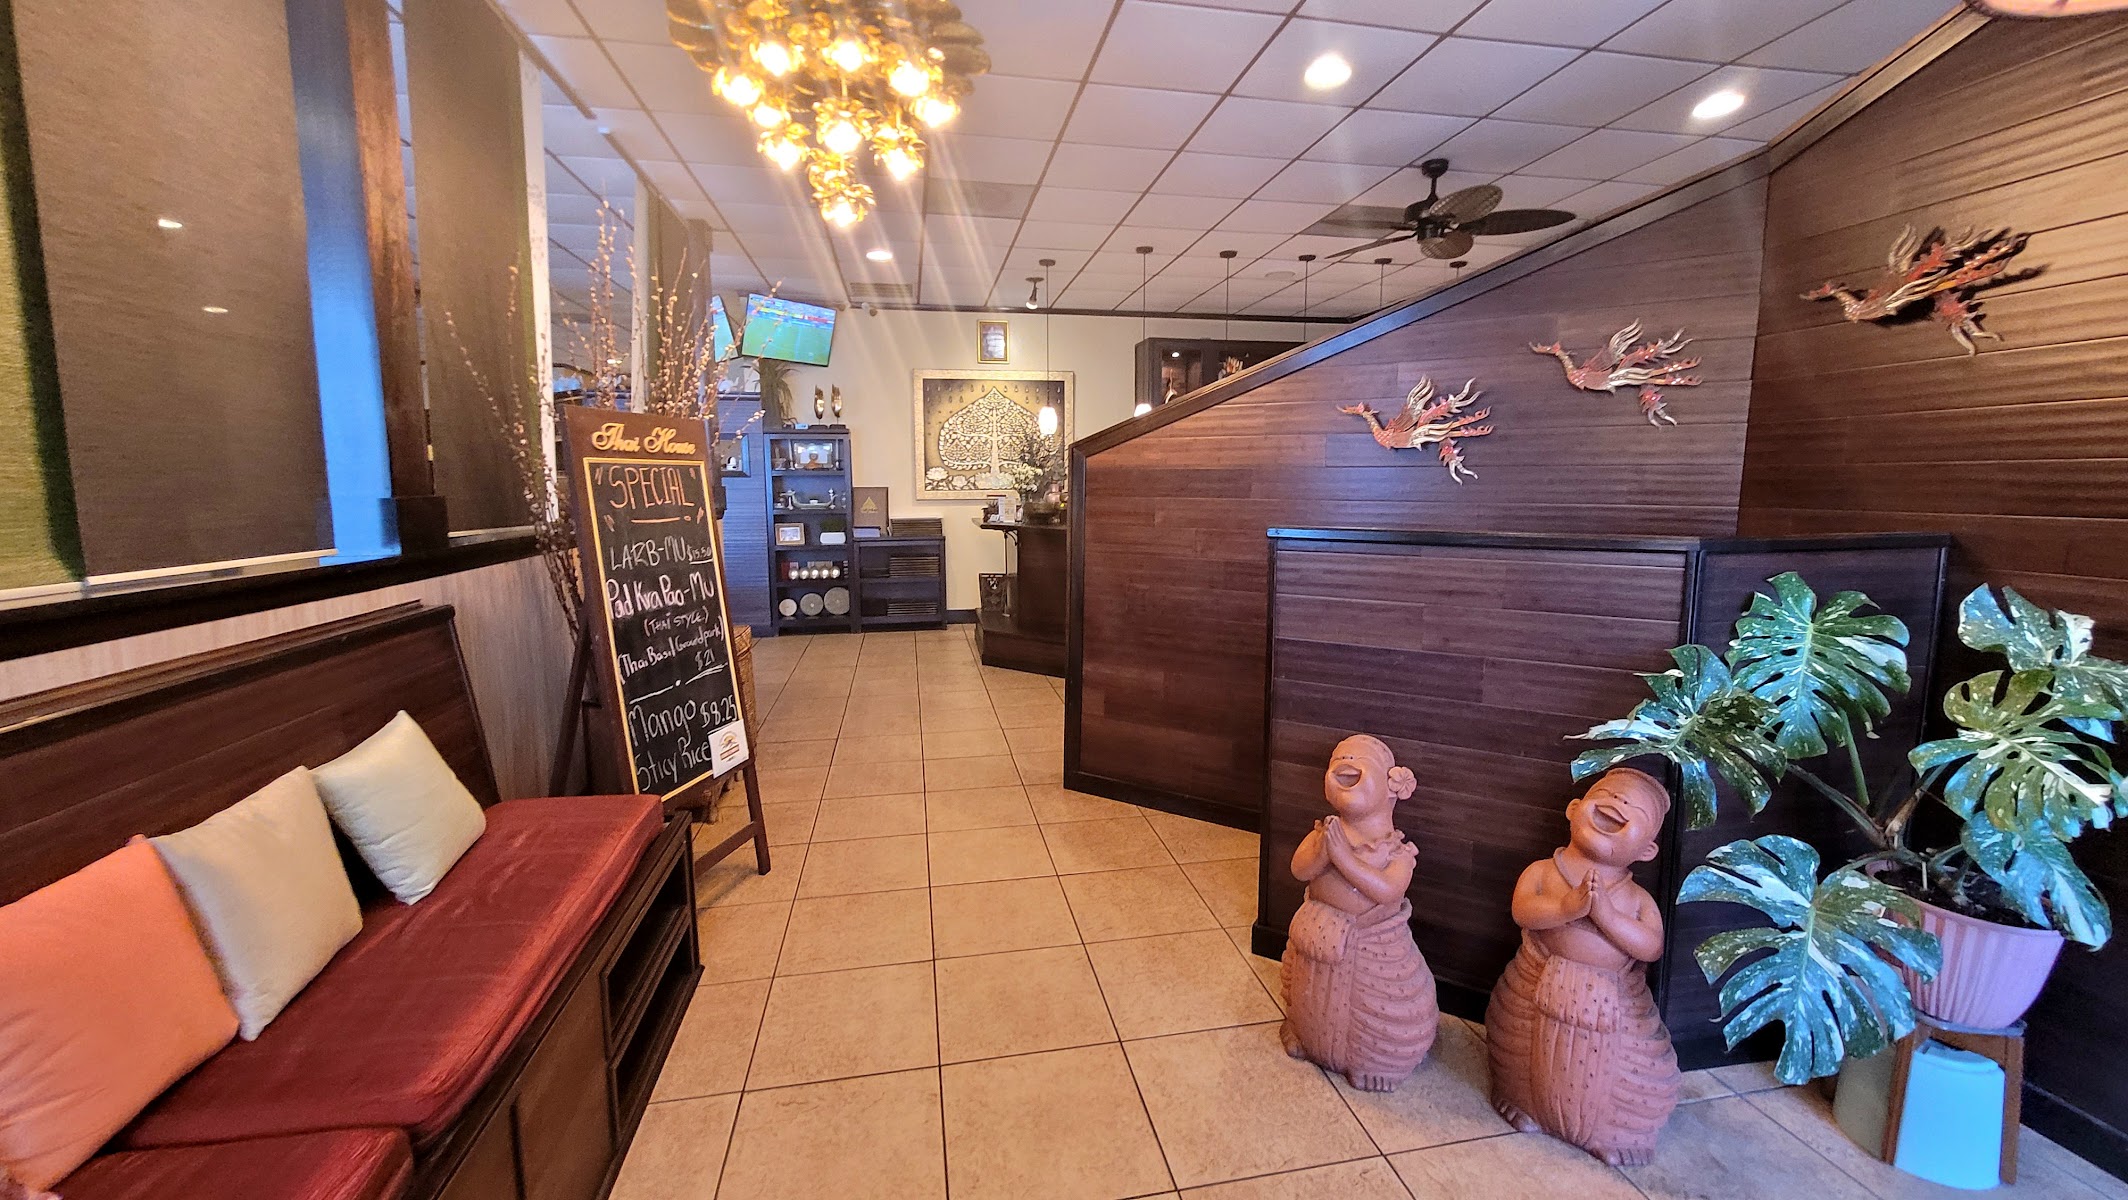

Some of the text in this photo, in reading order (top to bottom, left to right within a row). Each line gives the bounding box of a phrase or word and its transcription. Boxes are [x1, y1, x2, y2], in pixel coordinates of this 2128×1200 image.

[592, 423, 696, 455] Thai House
[610, 535, 686, 572] LARB-MU
[605, 578, 634, 620] Pad
[633, 580, 664, 612] Kra
[616, 653, 649, 686] (Thai
[646, 636, 676, 667] Basil
[694, 648, 716, 671] $21
[627, 694, 738, 748] Mango $8.25
[677, 736, 712, 769] Rice
